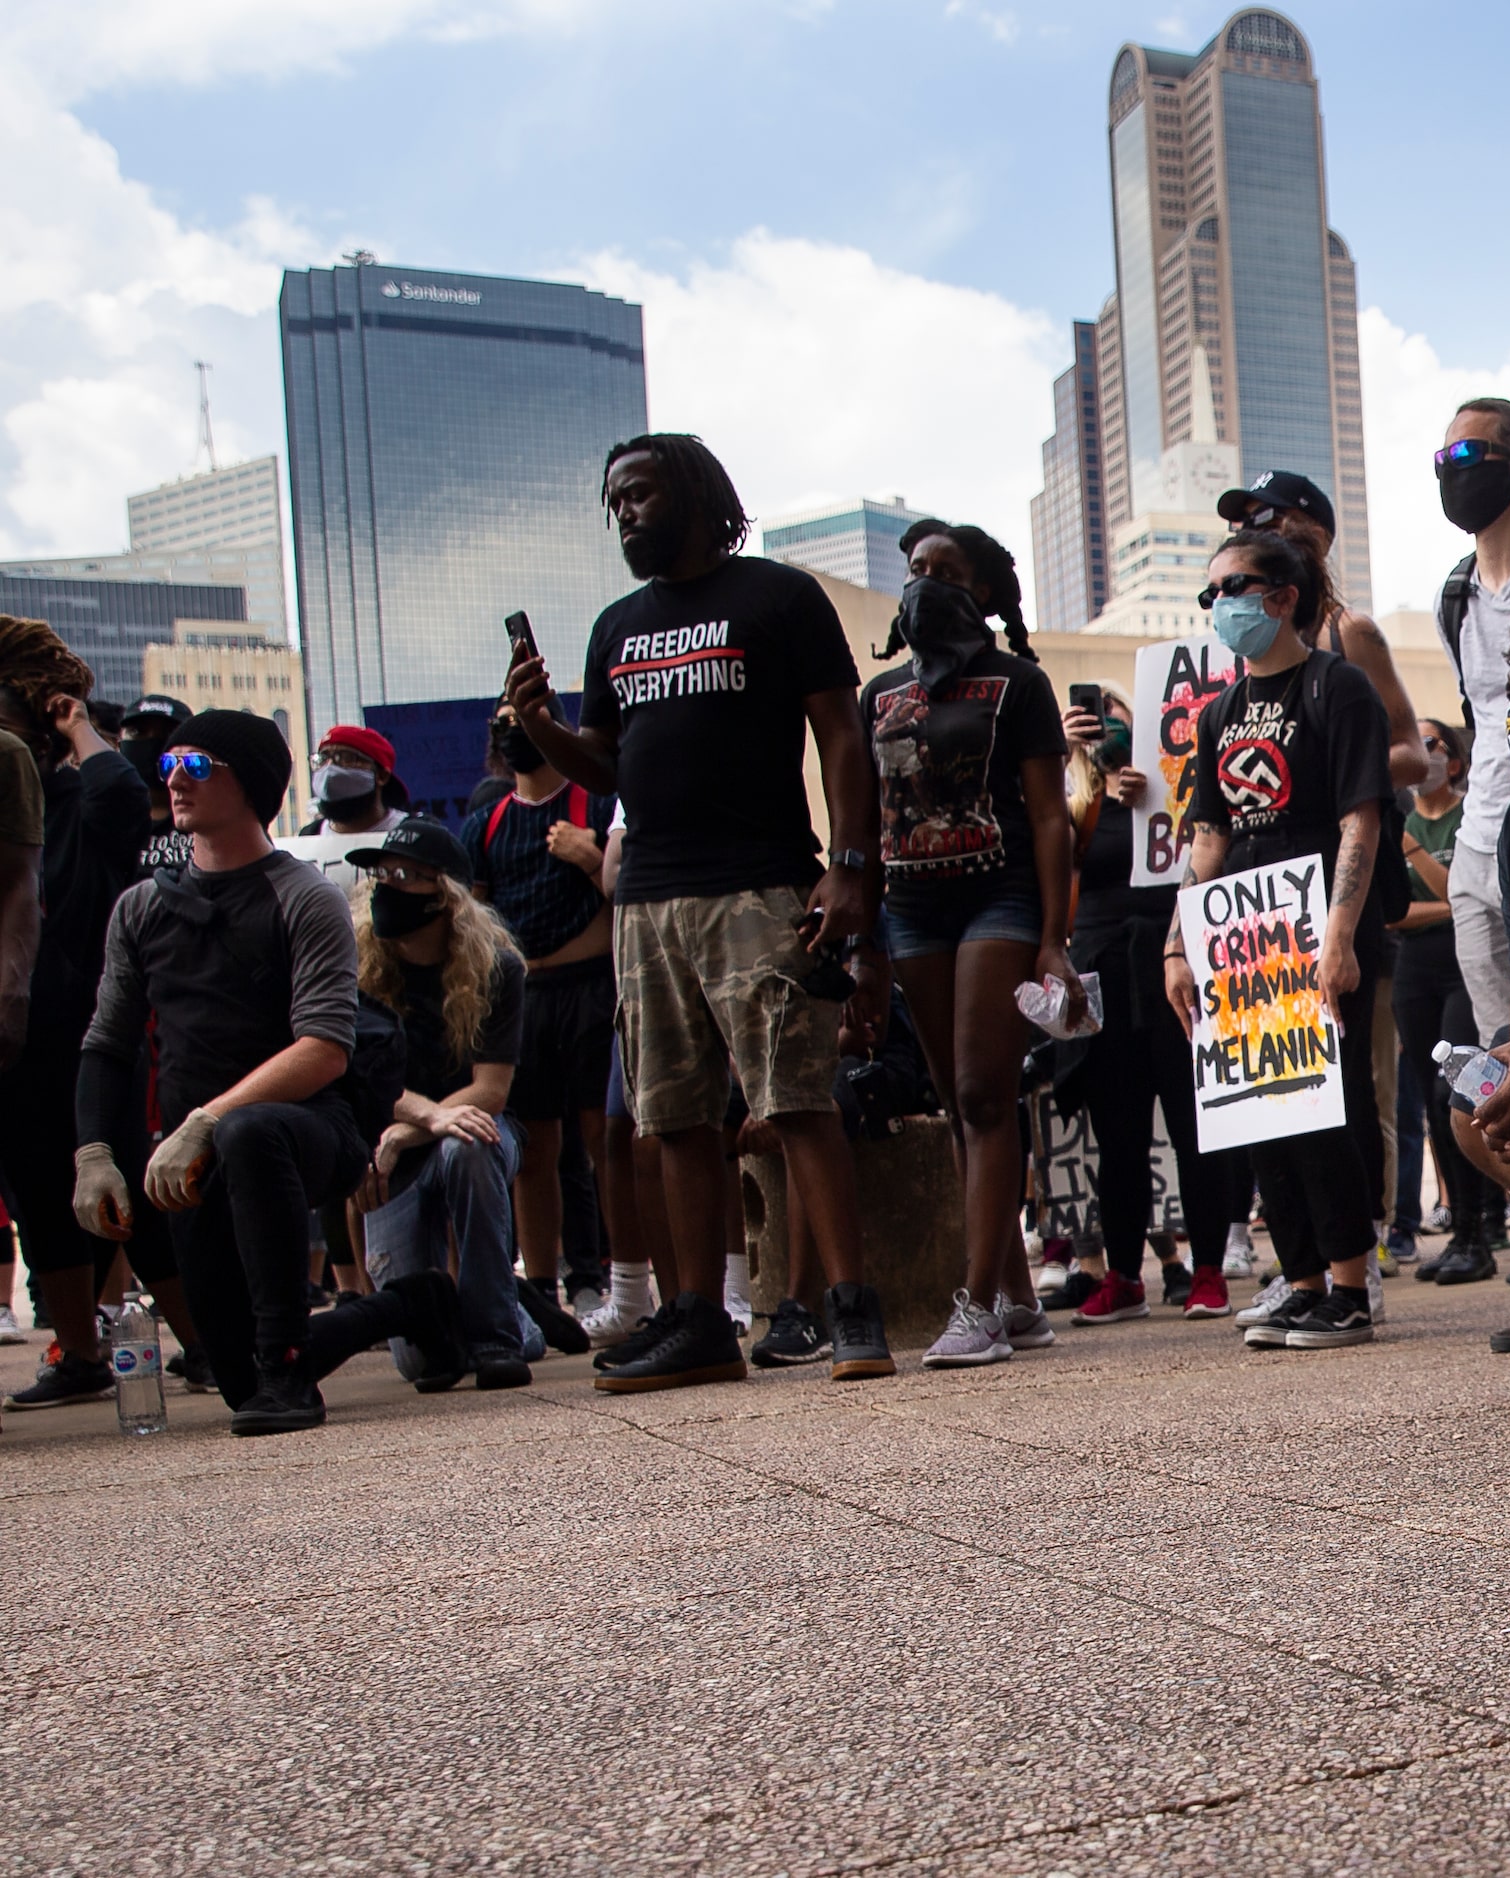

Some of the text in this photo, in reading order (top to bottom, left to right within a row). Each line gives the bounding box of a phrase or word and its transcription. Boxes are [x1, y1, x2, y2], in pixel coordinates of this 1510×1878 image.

[400, 281, 482, 306] Santander
[620, 619, 729, 664] FREEDOM
[612, 658, 746, 711] EVERYTHING
[1244, 701, 1283, 723] DEAD
[1203, 863, 1316, 926] ONLY
[1207, 912, 1320, 973] CRIME
[1196, 1022, 1337, 1090] MELANIN
